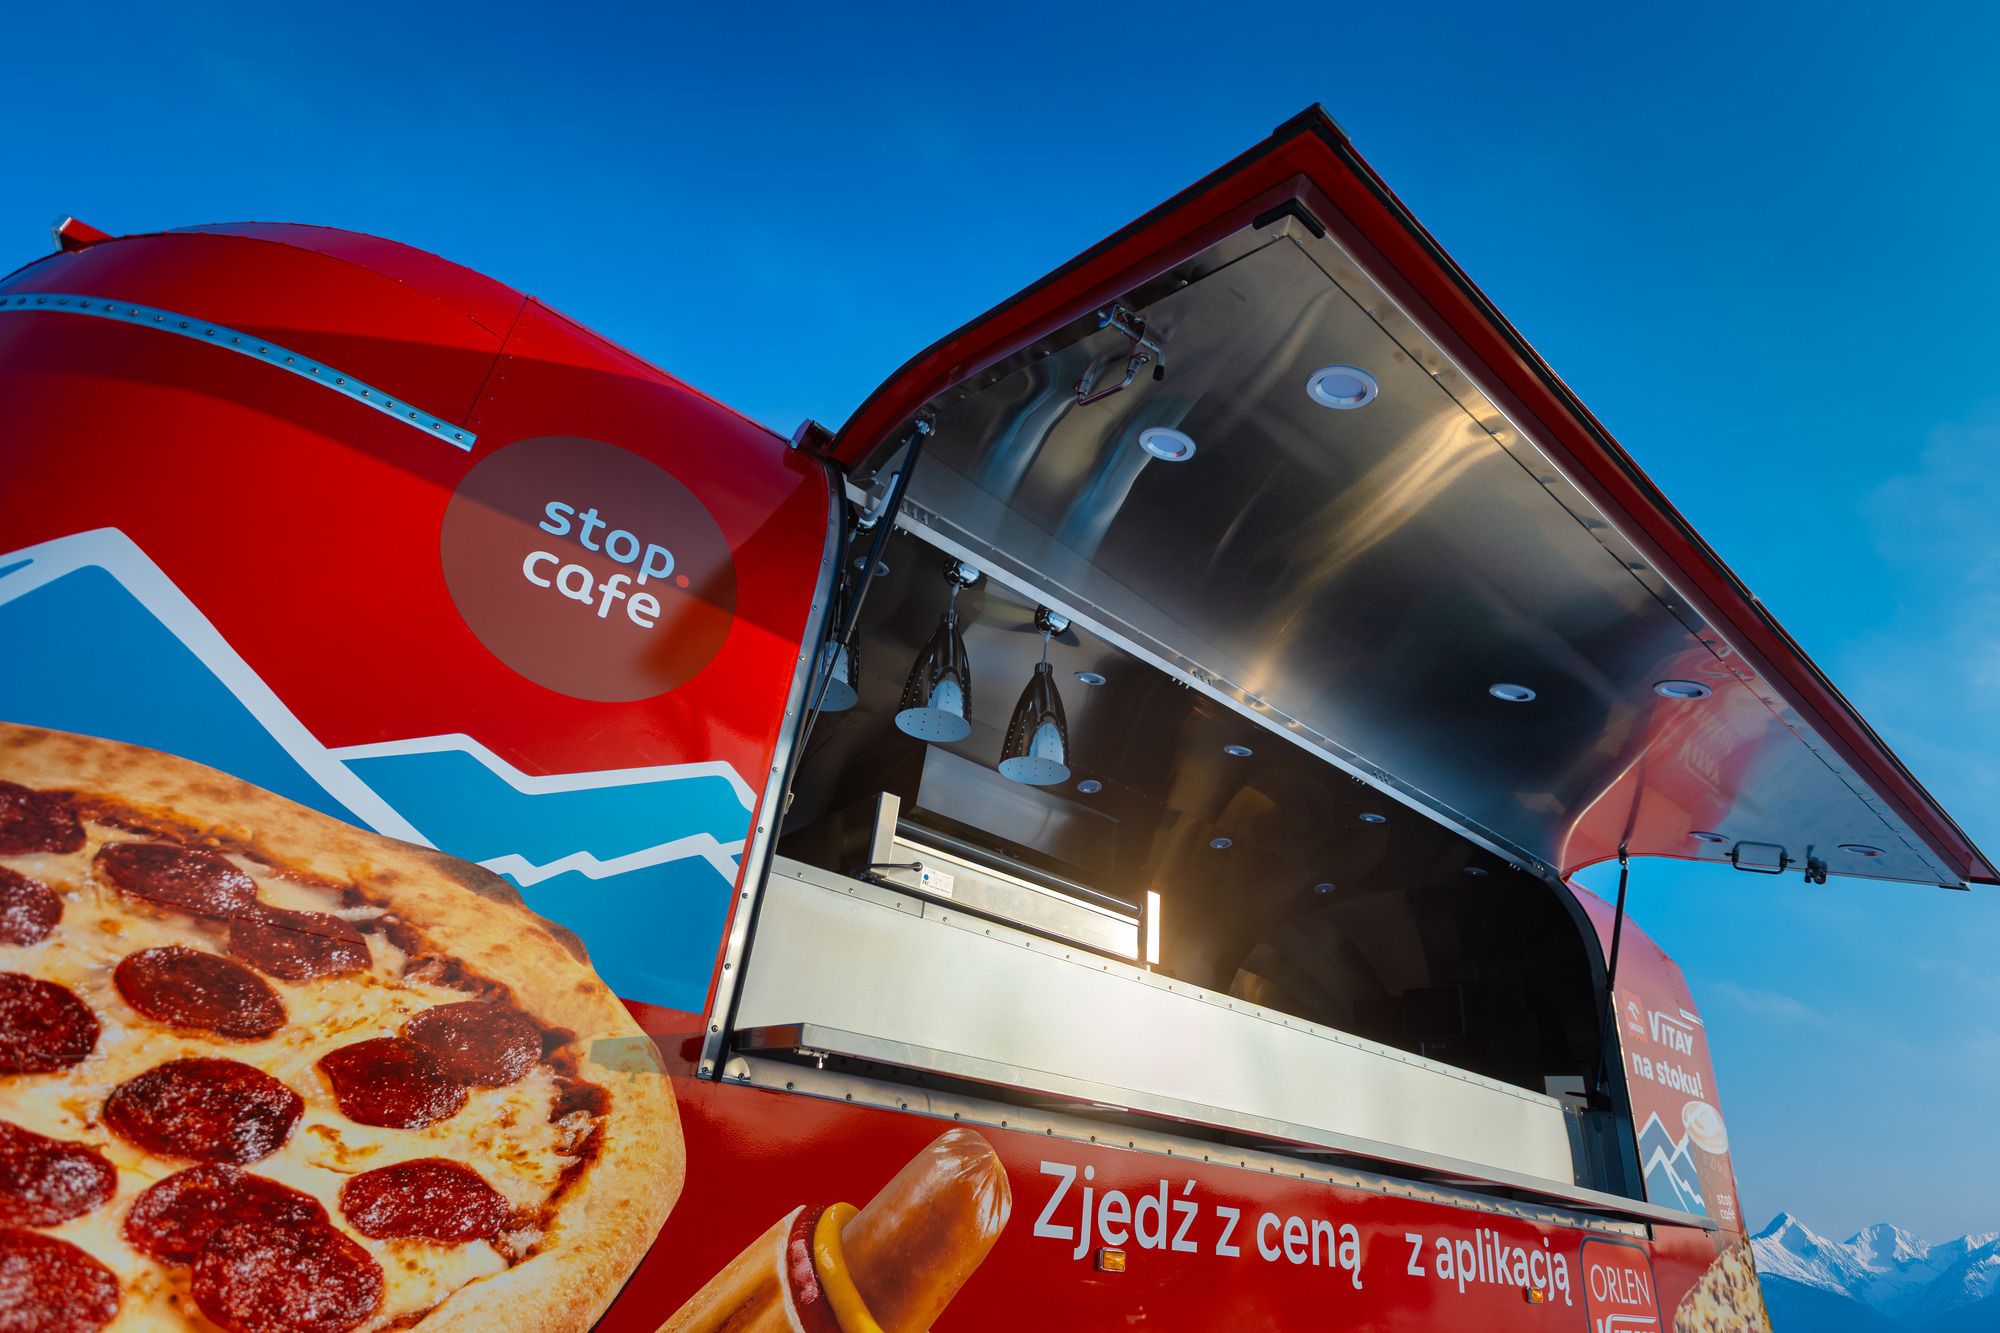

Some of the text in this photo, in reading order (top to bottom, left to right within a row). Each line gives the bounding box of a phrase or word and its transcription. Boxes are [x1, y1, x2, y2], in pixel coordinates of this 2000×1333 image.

[522, 551, 661, 629] cafe
[1631, 1052, 1705, 1099] na stoku!
[1033, 1160, 1573, 1307] Zjedź z ceną z aplikacją
[1590, 1263, 1651, 1307] ORLEN
